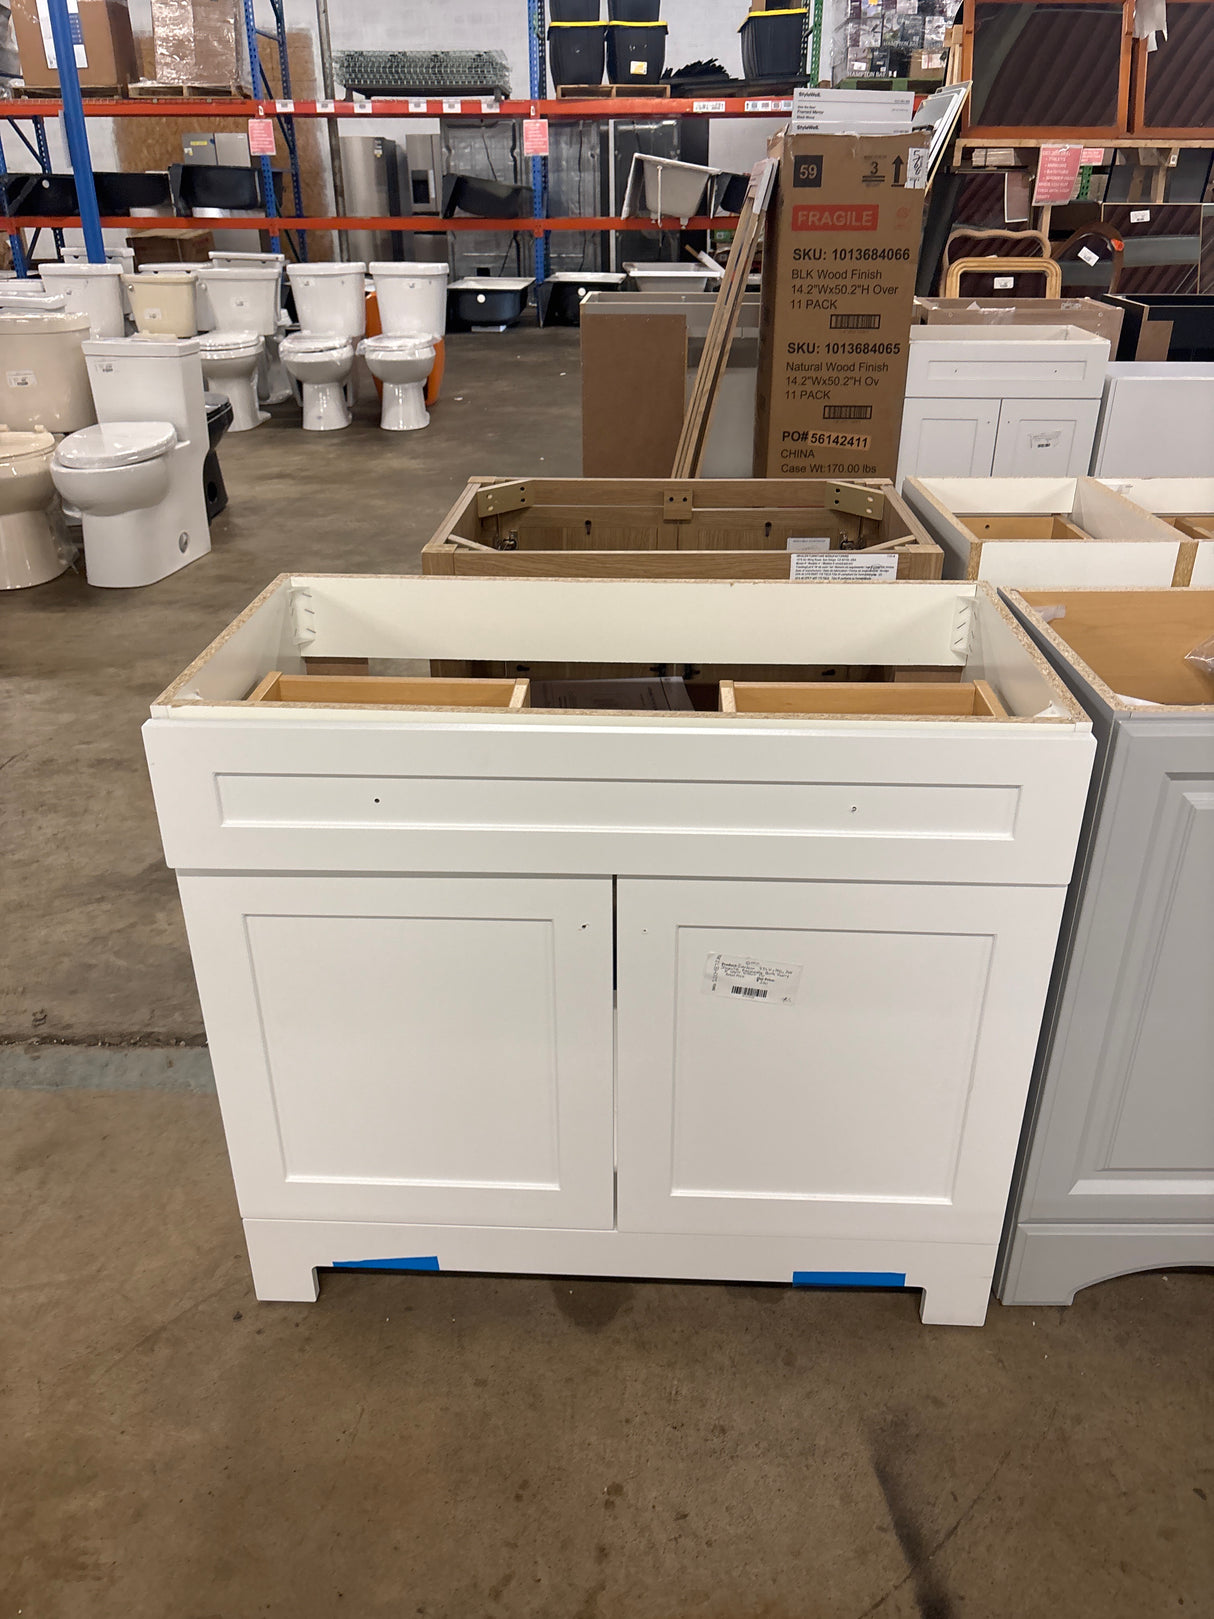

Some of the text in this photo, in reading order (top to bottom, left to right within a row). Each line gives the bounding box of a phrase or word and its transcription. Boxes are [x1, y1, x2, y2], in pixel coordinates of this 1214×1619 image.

[799, 164, 818, 179] 59
[869, 161, 879, 175] 3
[797, 210, 874, 226] FRAGILE
[792, 248, 910, 261] SKU: 1013684066
[791, 269, 882, 279] BLK Wood Finish
[791, 284, 899, 295] 14.2"Wx50.2"H Over
[791, 299, 838, 310] 11 PACK
[787, 342, 900, 355] SKU: 1013684065
[785, 362, 889, 372] Natural Wood Finish
[786, 376, 880, 386] 14.2"Wx50.2"H Ov
[785, 390, 831, 400] 11 PACK
[782, 431, 868, 448] PO# 56142411
[780, 449, 815, 459] CHINA
[780, 464, 806, 473] Case
[862, 464, 877, 473] lbs
